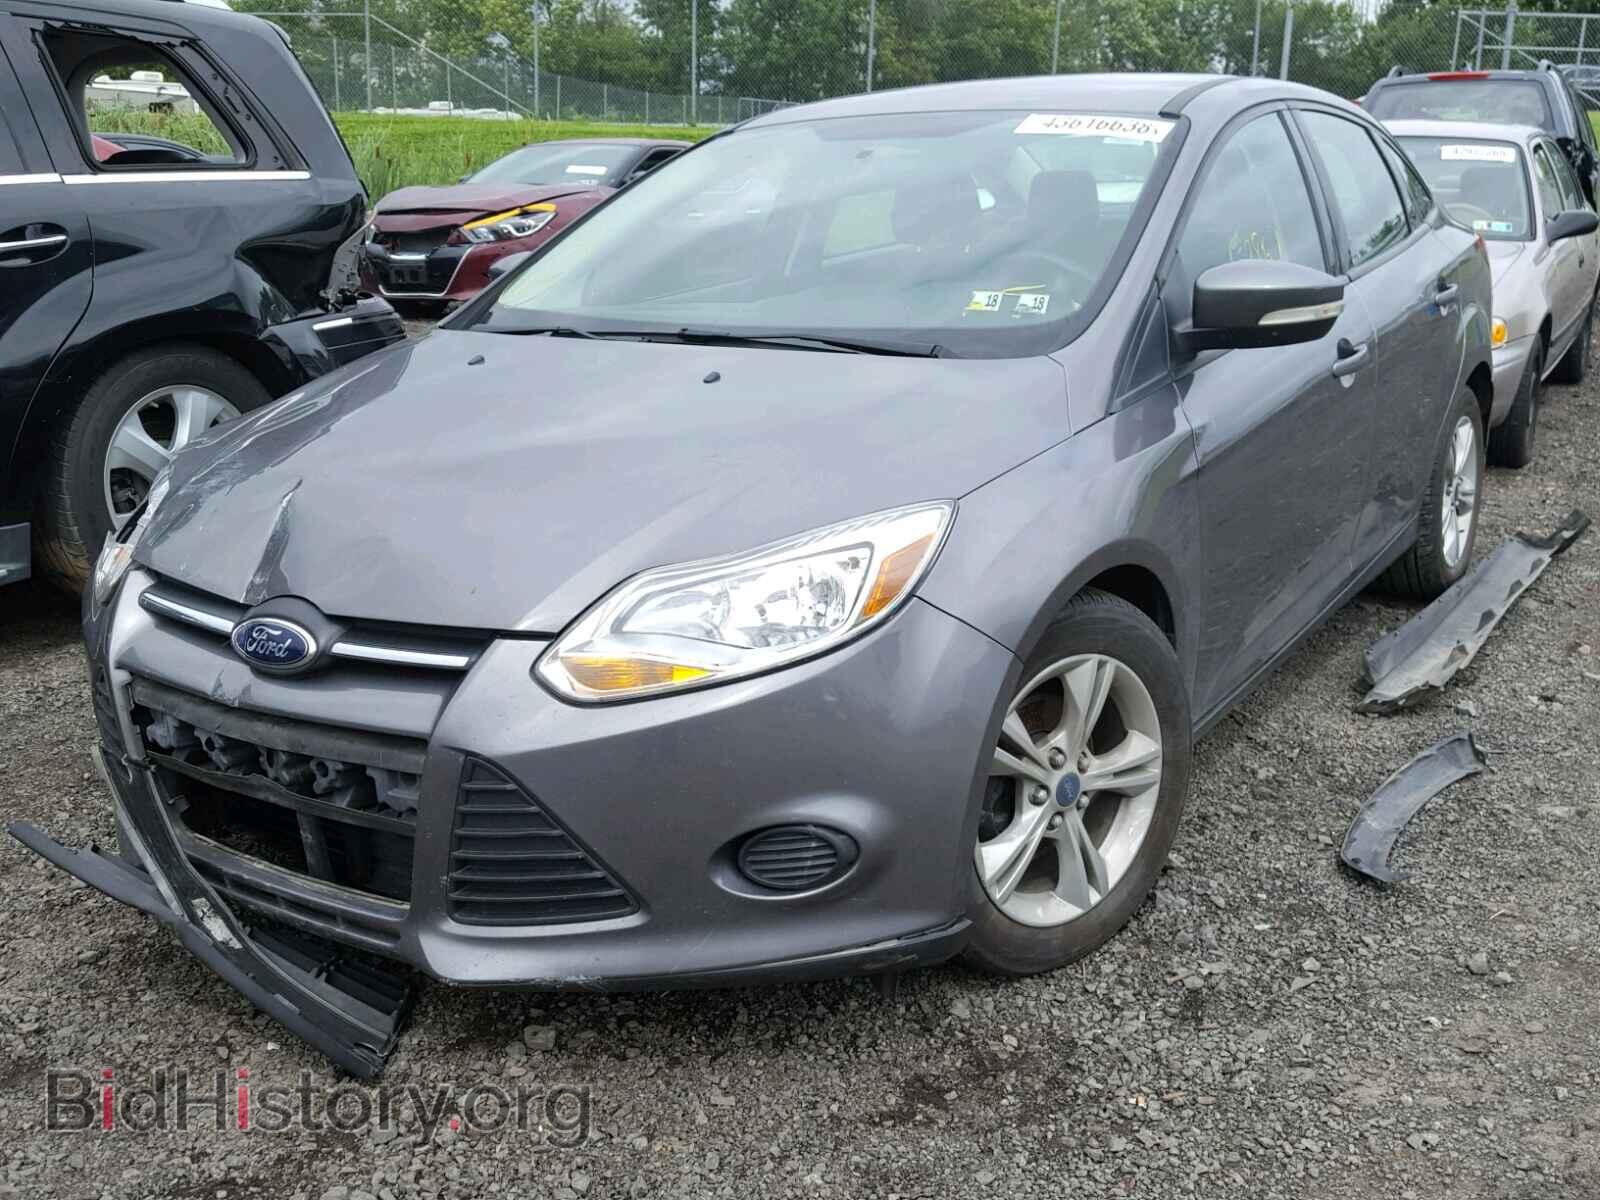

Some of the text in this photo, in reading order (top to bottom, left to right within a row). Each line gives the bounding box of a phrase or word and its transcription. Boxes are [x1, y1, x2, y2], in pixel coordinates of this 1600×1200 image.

[984, 294, 999, 307] 18
[1032, 296, 1045, 310] 18
[246, 625, 292, 658] Ford
